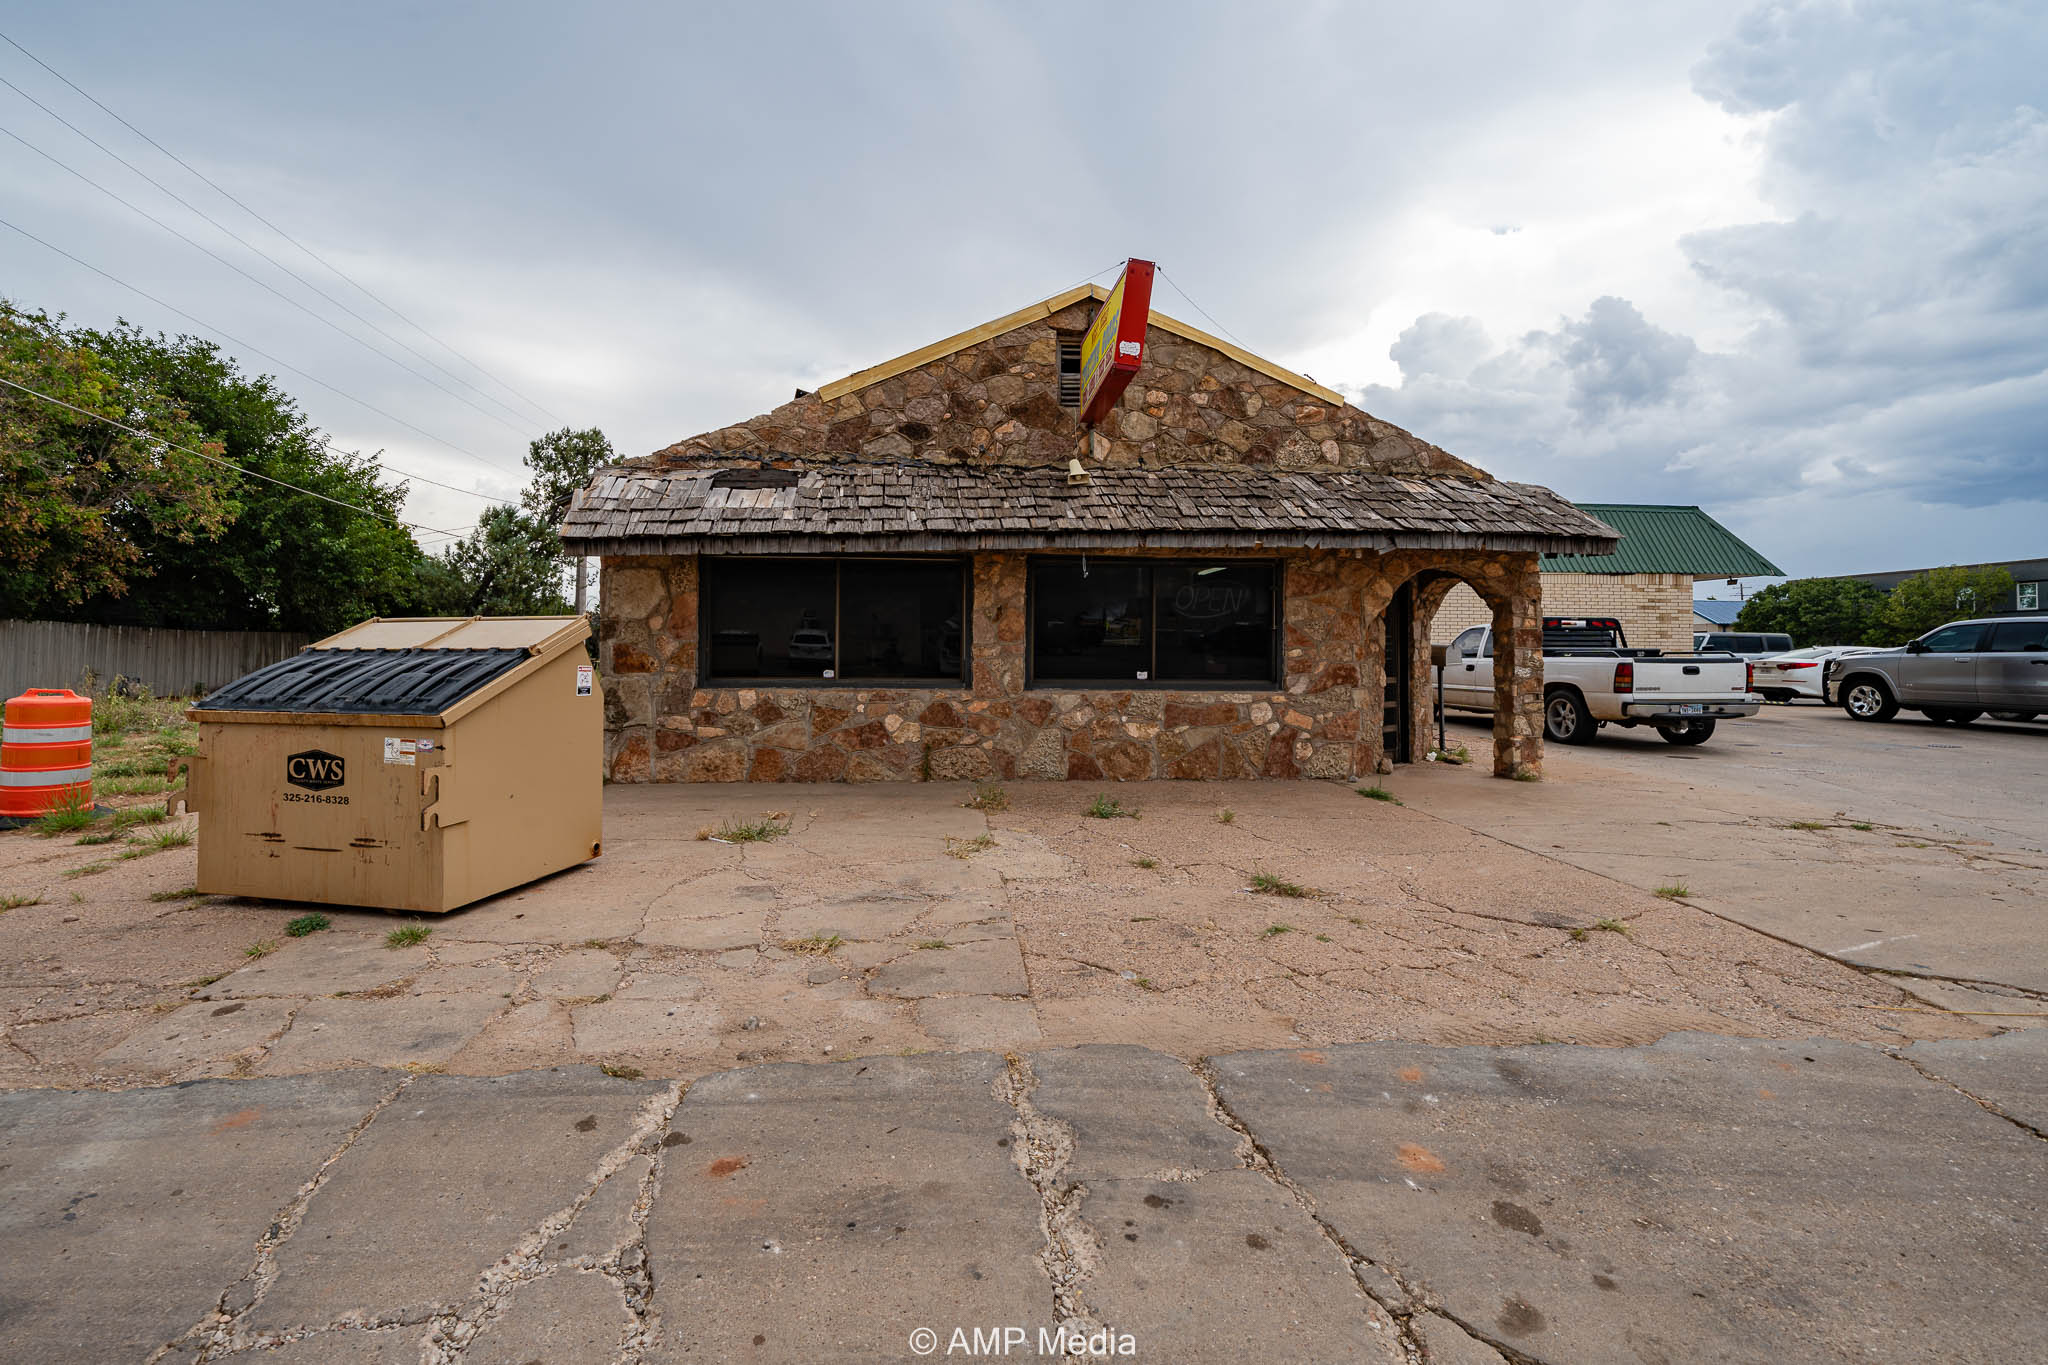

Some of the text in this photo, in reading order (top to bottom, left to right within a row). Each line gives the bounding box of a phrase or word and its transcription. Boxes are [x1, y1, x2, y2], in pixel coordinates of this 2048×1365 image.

[1176, 586, 1243, 611] OPEN
[288, 757, 343, 780] CWS
[283, 792, 350, 806] 325-216-8328
